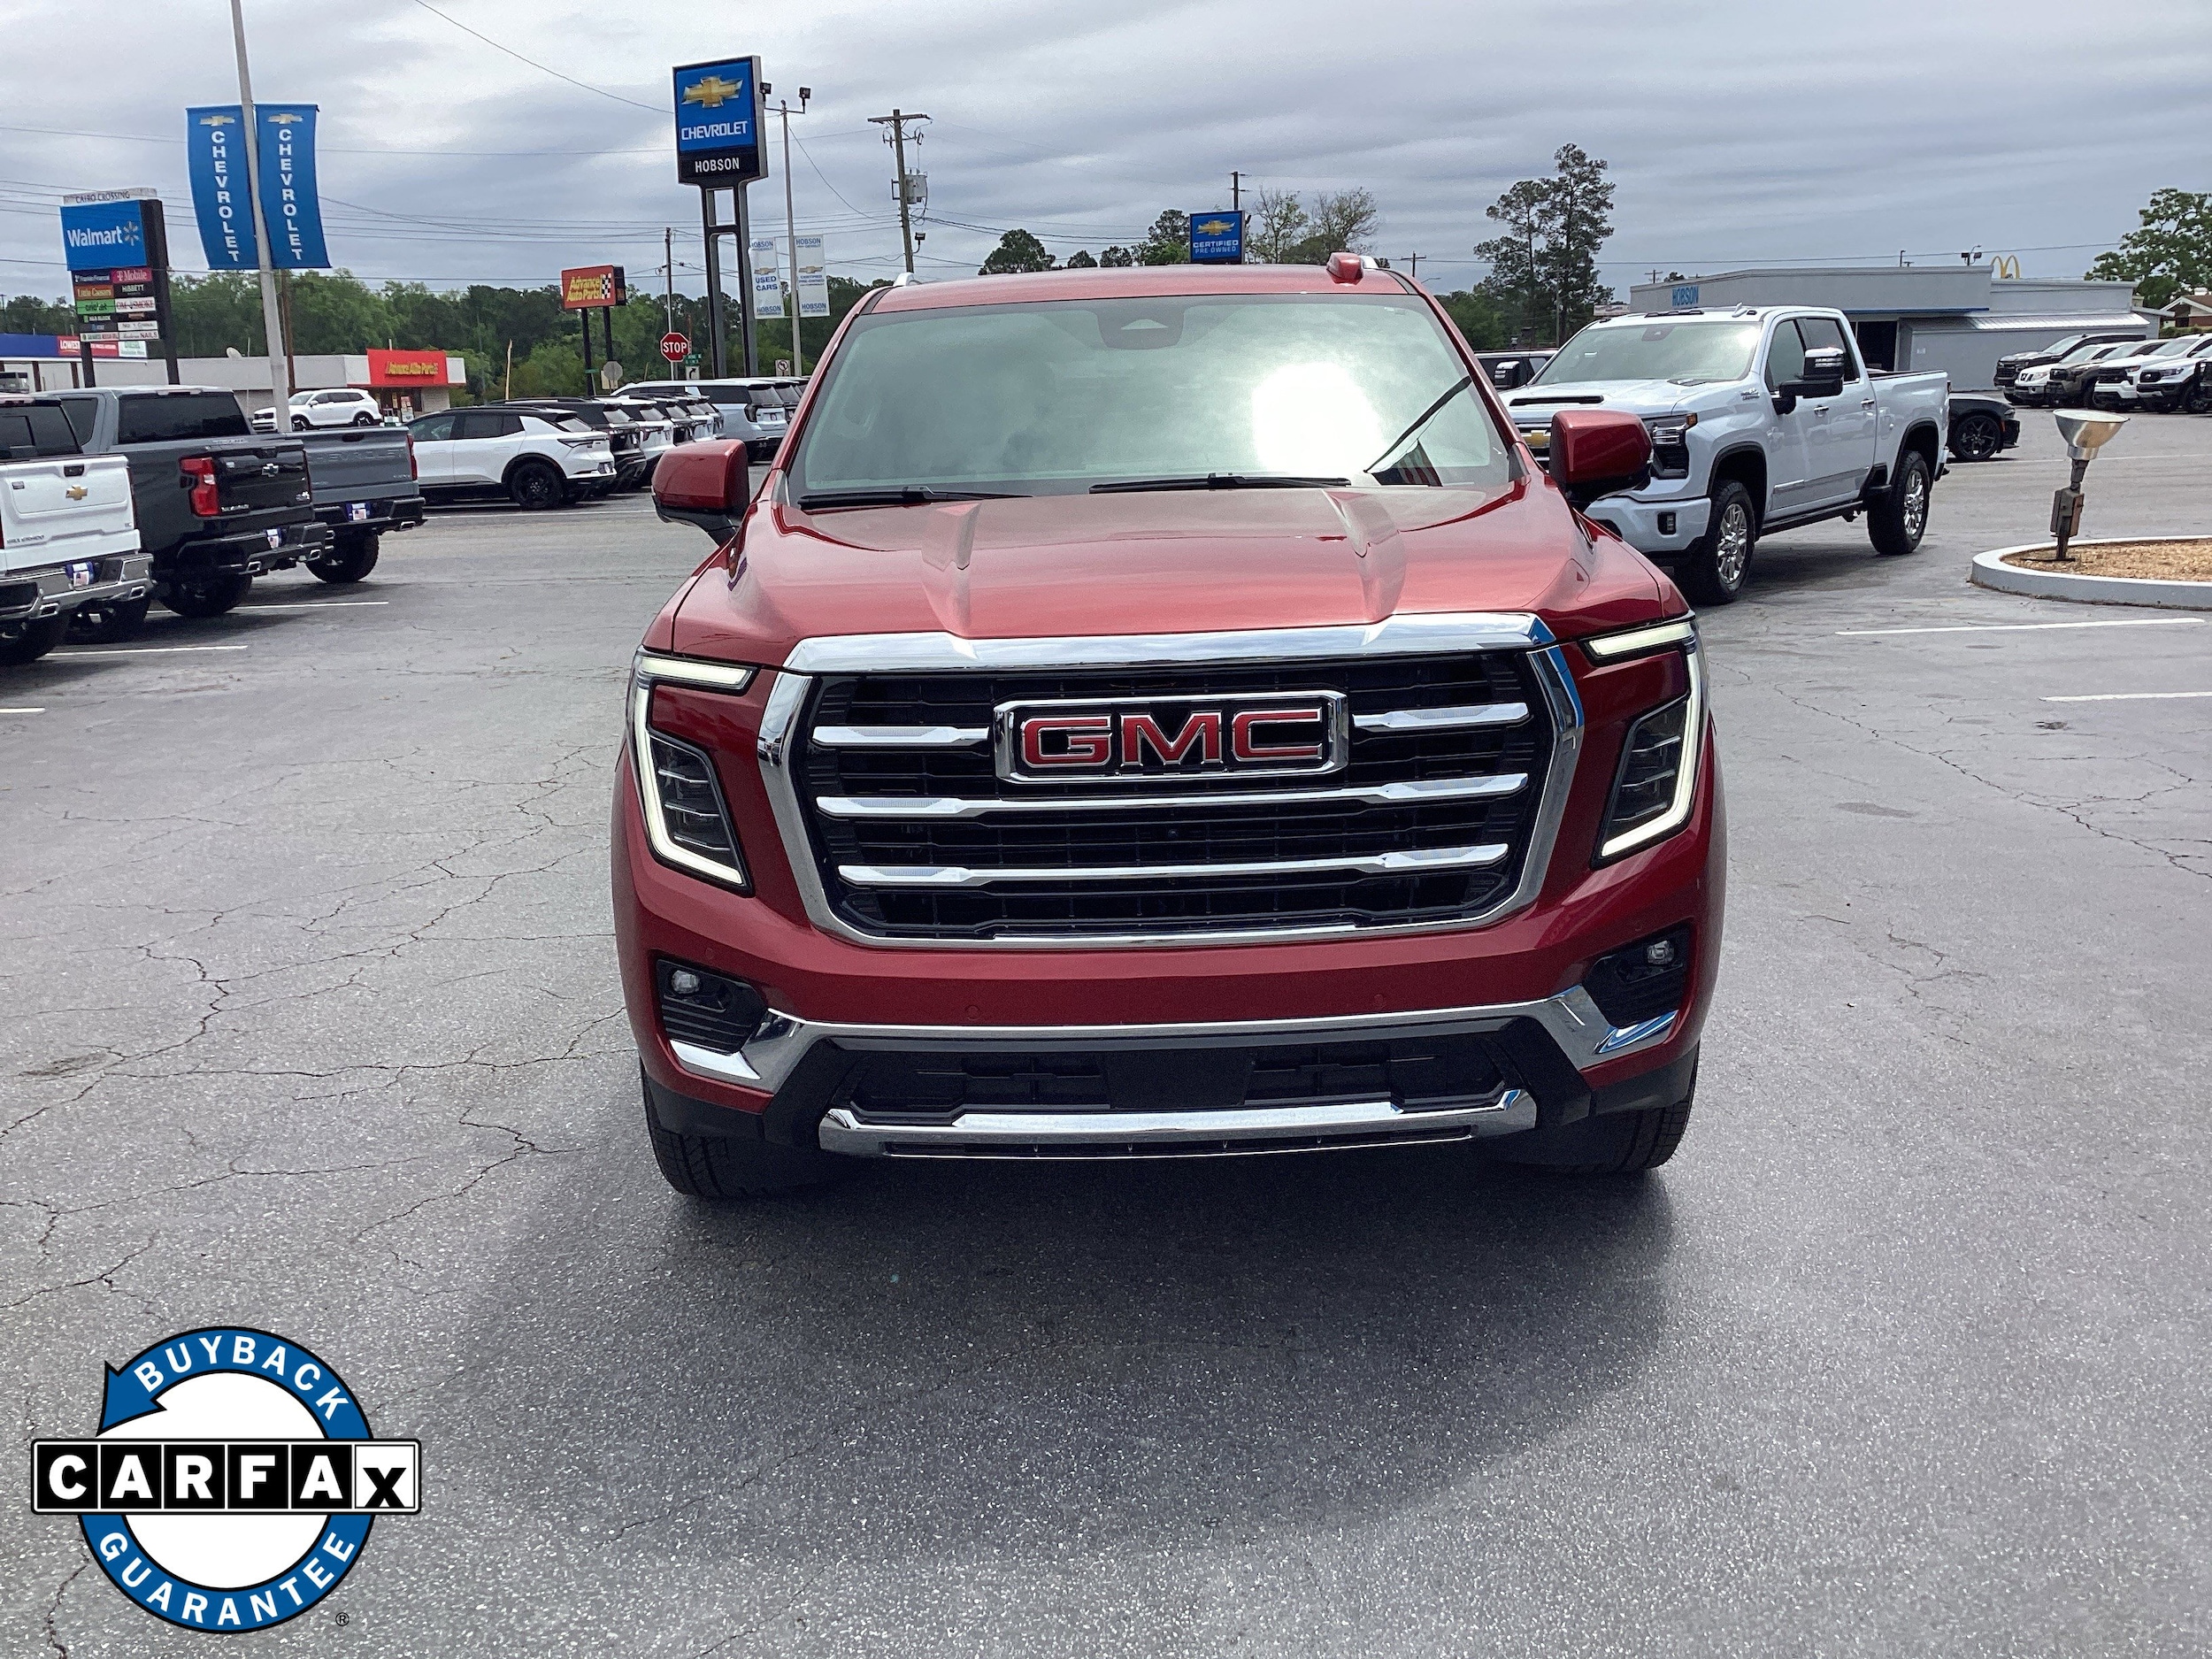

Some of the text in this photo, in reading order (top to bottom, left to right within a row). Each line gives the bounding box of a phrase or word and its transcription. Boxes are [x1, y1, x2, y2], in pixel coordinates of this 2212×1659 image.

[680, 120, 748, 141] CHEVROLET
[695, 157, 740, 173] HOBSON
[97, 190, 131, 202] CROSSING
[211, 131, 240, 262] CHEVROLET
[278, 128, 303, 261] CHEVROLET
[67, 226, 123, 248] Walmart
[1193, 239, 1239, 249] CERTIFIED
[570, 275, 601, 289] Advance
[755, 275, 777, 284] USED
[566, 288, 601, 302] Auto Parts
[1671, 285, 1699, 307] HOBSON
[663, 342, 687, 353] STOP
[1020, 707, 1324, 769] GMC
